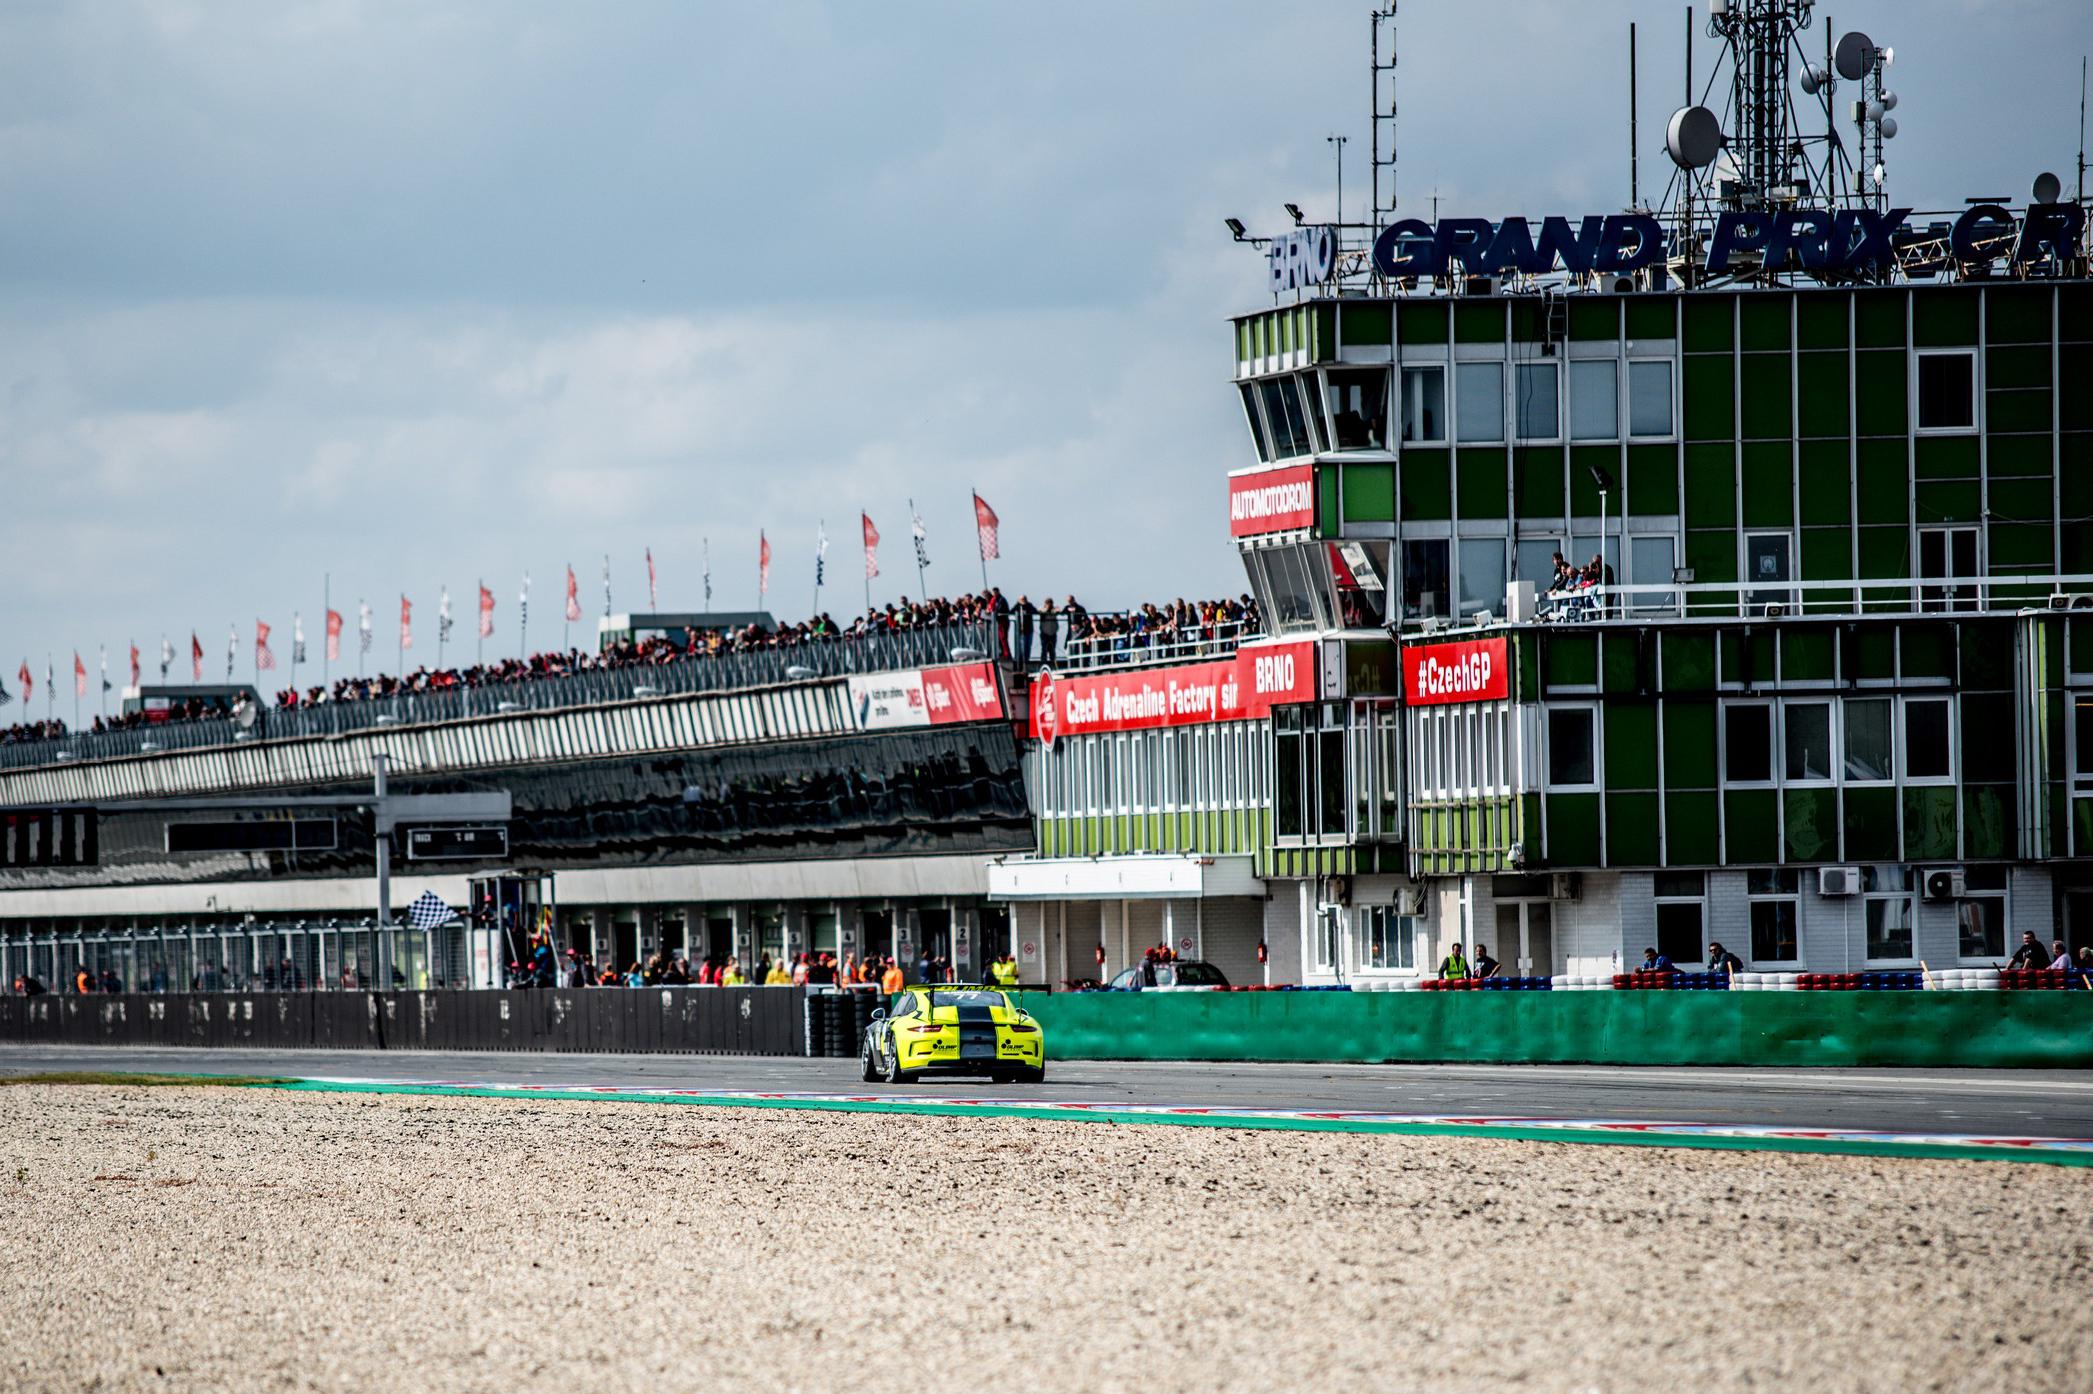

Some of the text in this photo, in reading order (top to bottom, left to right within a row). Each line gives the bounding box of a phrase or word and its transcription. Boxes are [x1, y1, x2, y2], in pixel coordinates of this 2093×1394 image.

[1270, 225, 1337, 292] BRNO
[1373, 215, 1662, 275] GRAND
[1705, 207, 1914, 271] PRIX
[1231, 481, 1312, 520] AUTOMOTODROM
[1255, 653, 1294, 694] BRNO
[1418, 652, 1491, 698] #CzechGP
[1066, 688, 1099, 724] Czech
[1103, 683, 1165, 721] Adrenaline
[1169, 680, 1217, 720] Factory
